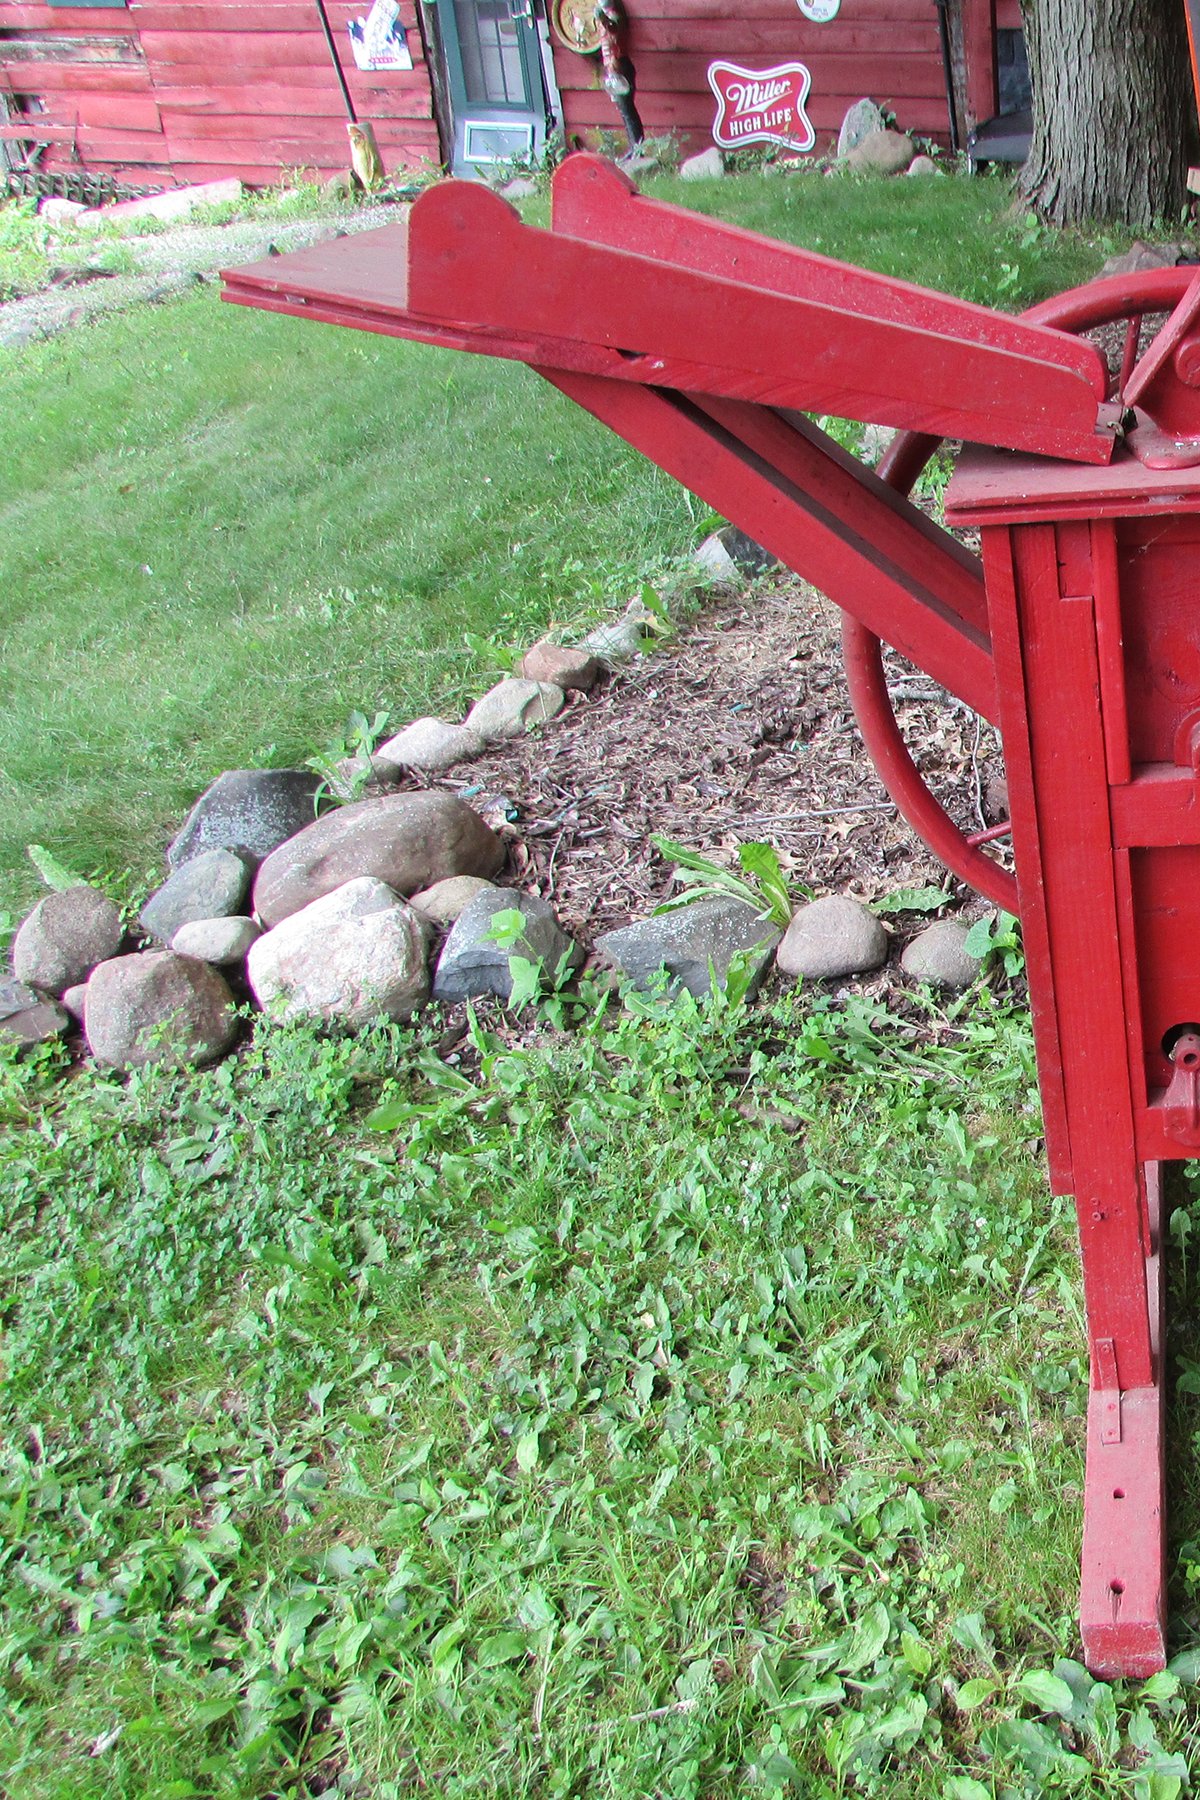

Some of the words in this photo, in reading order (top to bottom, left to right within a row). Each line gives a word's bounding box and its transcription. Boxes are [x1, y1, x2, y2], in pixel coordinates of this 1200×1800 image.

[726, 80, 791, 113] Miller
[729, 116, 761, 136] HIGH
[763, 108, 792, 128] LIFE
